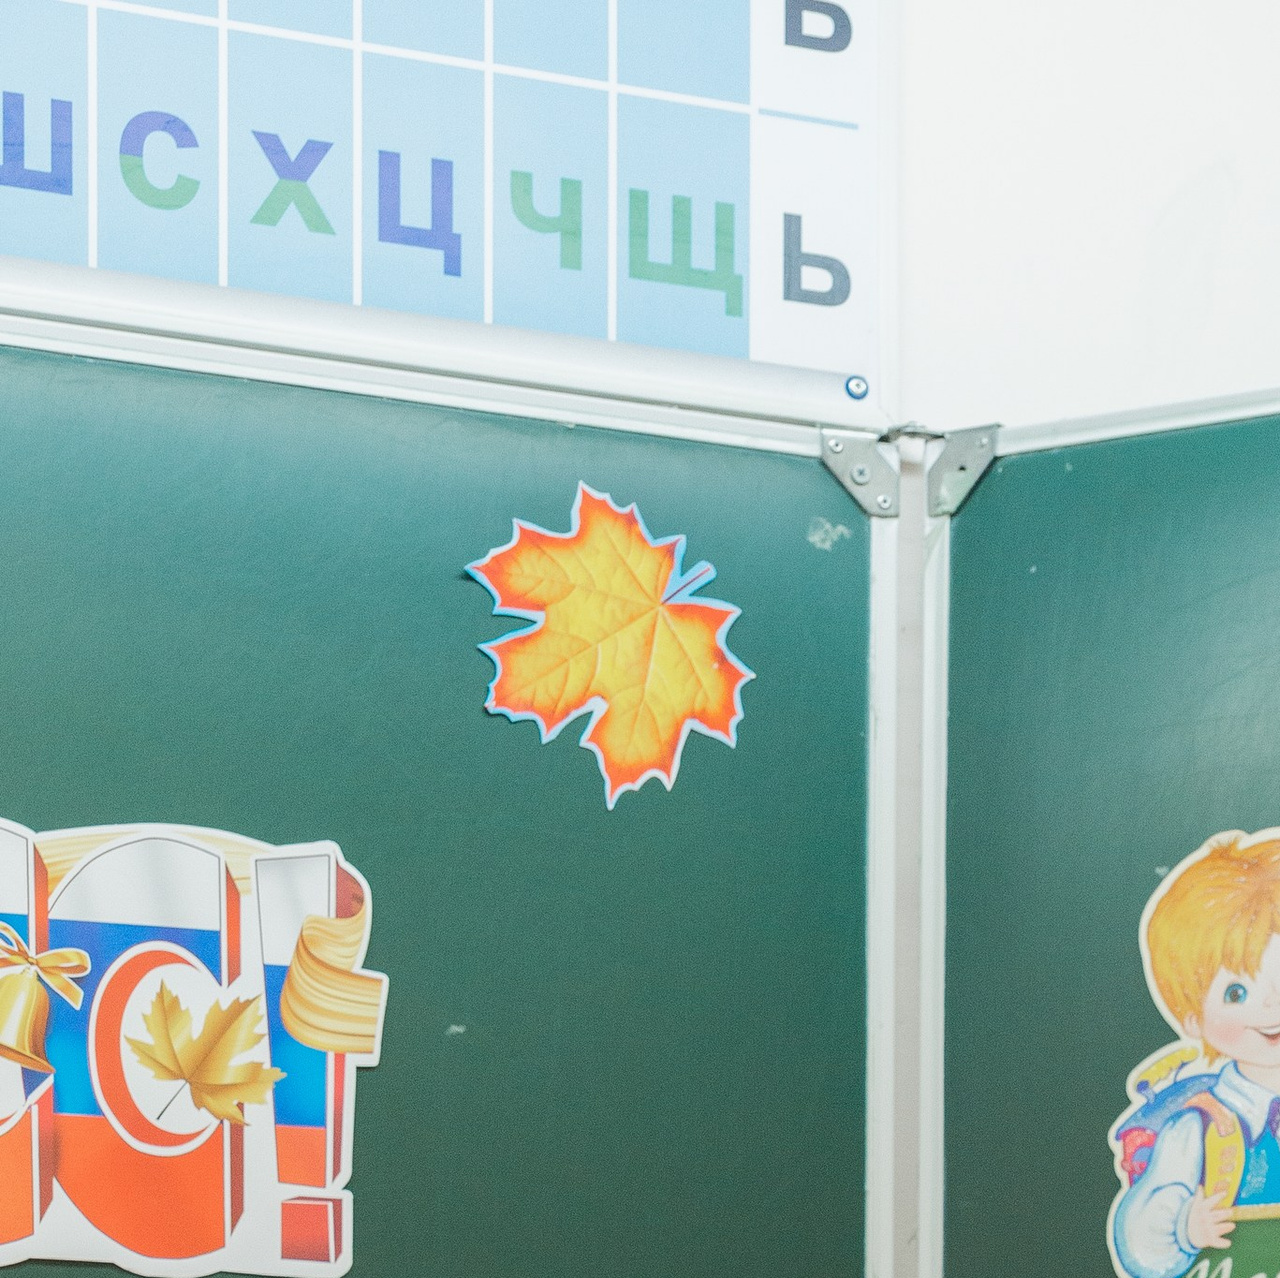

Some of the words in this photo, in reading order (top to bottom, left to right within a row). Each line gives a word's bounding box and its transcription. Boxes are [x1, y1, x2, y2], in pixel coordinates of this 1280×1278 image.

[119, 110, 201, 211] С
[250, 130, 336, 235] Х
[378, 149, 462, 278] Ц
[510, 170, 583, 271] Ч
[628, 187, 744, 319] Щ
[783, 213, 852, 307] Ь
[0, 825, 352, 1264] С!
